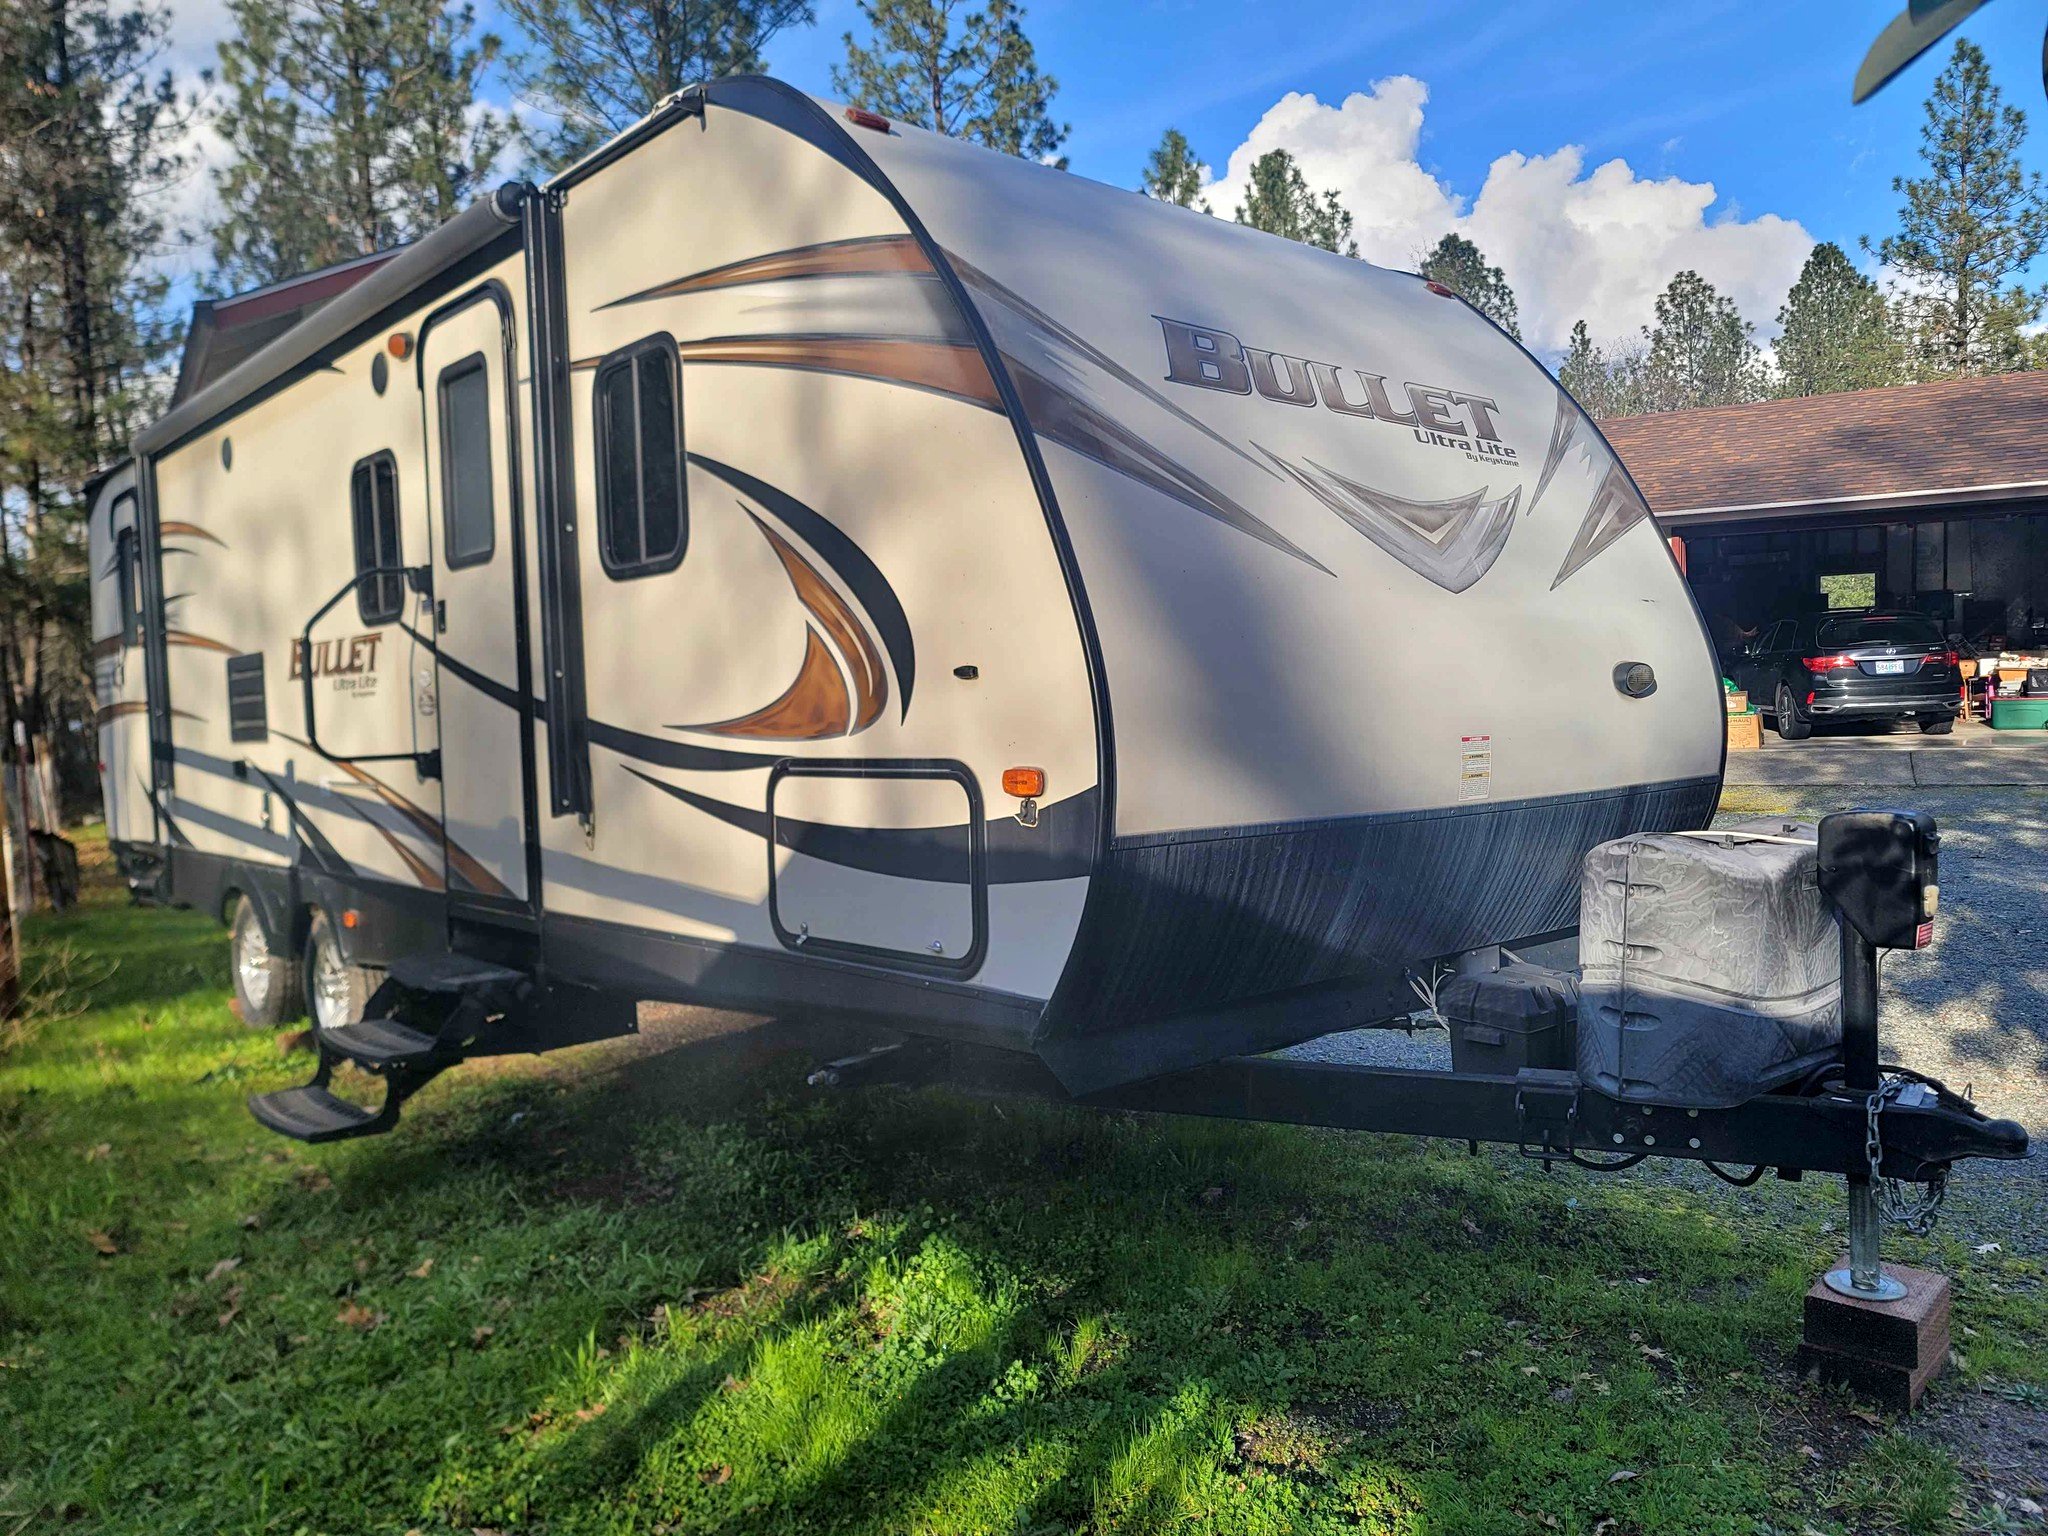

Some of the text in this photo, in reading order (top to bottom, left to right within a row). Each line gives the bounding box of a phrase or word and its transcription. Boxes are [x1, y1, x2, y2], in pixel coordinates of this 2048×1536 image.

[1151, 314, 1503, 442] BULLET
[1413, 429, 1517, 458] Ultra Lite
[1466, 452, 1520, 467] By Keystone
